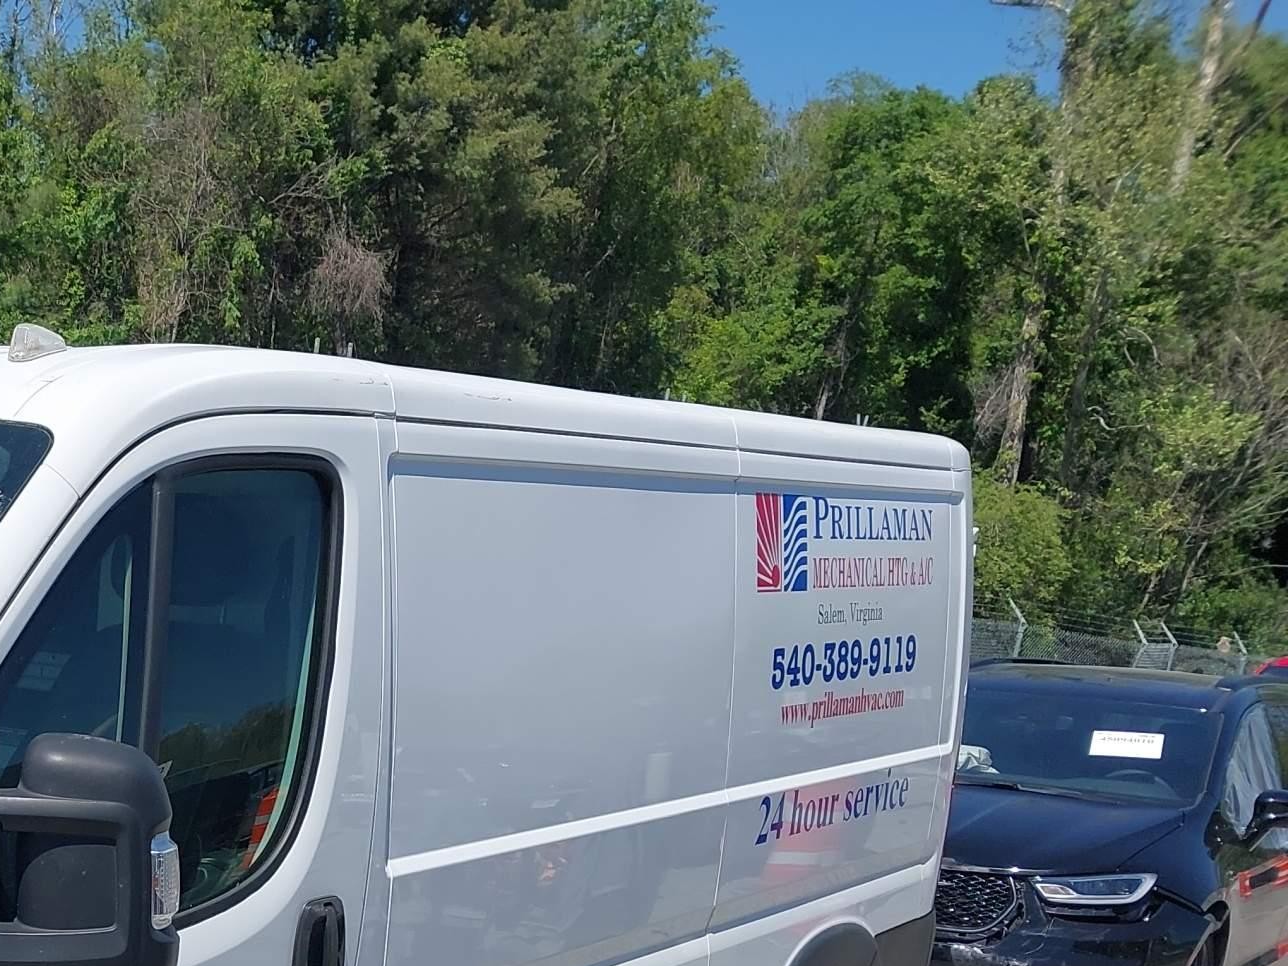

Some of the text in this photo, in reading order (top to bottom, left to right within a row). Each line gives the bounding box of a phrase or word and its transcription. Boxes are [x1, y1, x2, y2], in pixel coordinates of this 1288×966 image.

[812, 496, 933, 541] PRILLAMAN
[812, 557, 933, 589] MECHANICAL HTG & A/C
[817, 601, 883, 626] Salem, Virginia
[771, 634, 917, 690] 540-389-9119
[781, 688, 904, 729] www.prillamanhvac.com
[755, 767, 910, 846] 24 hour service
